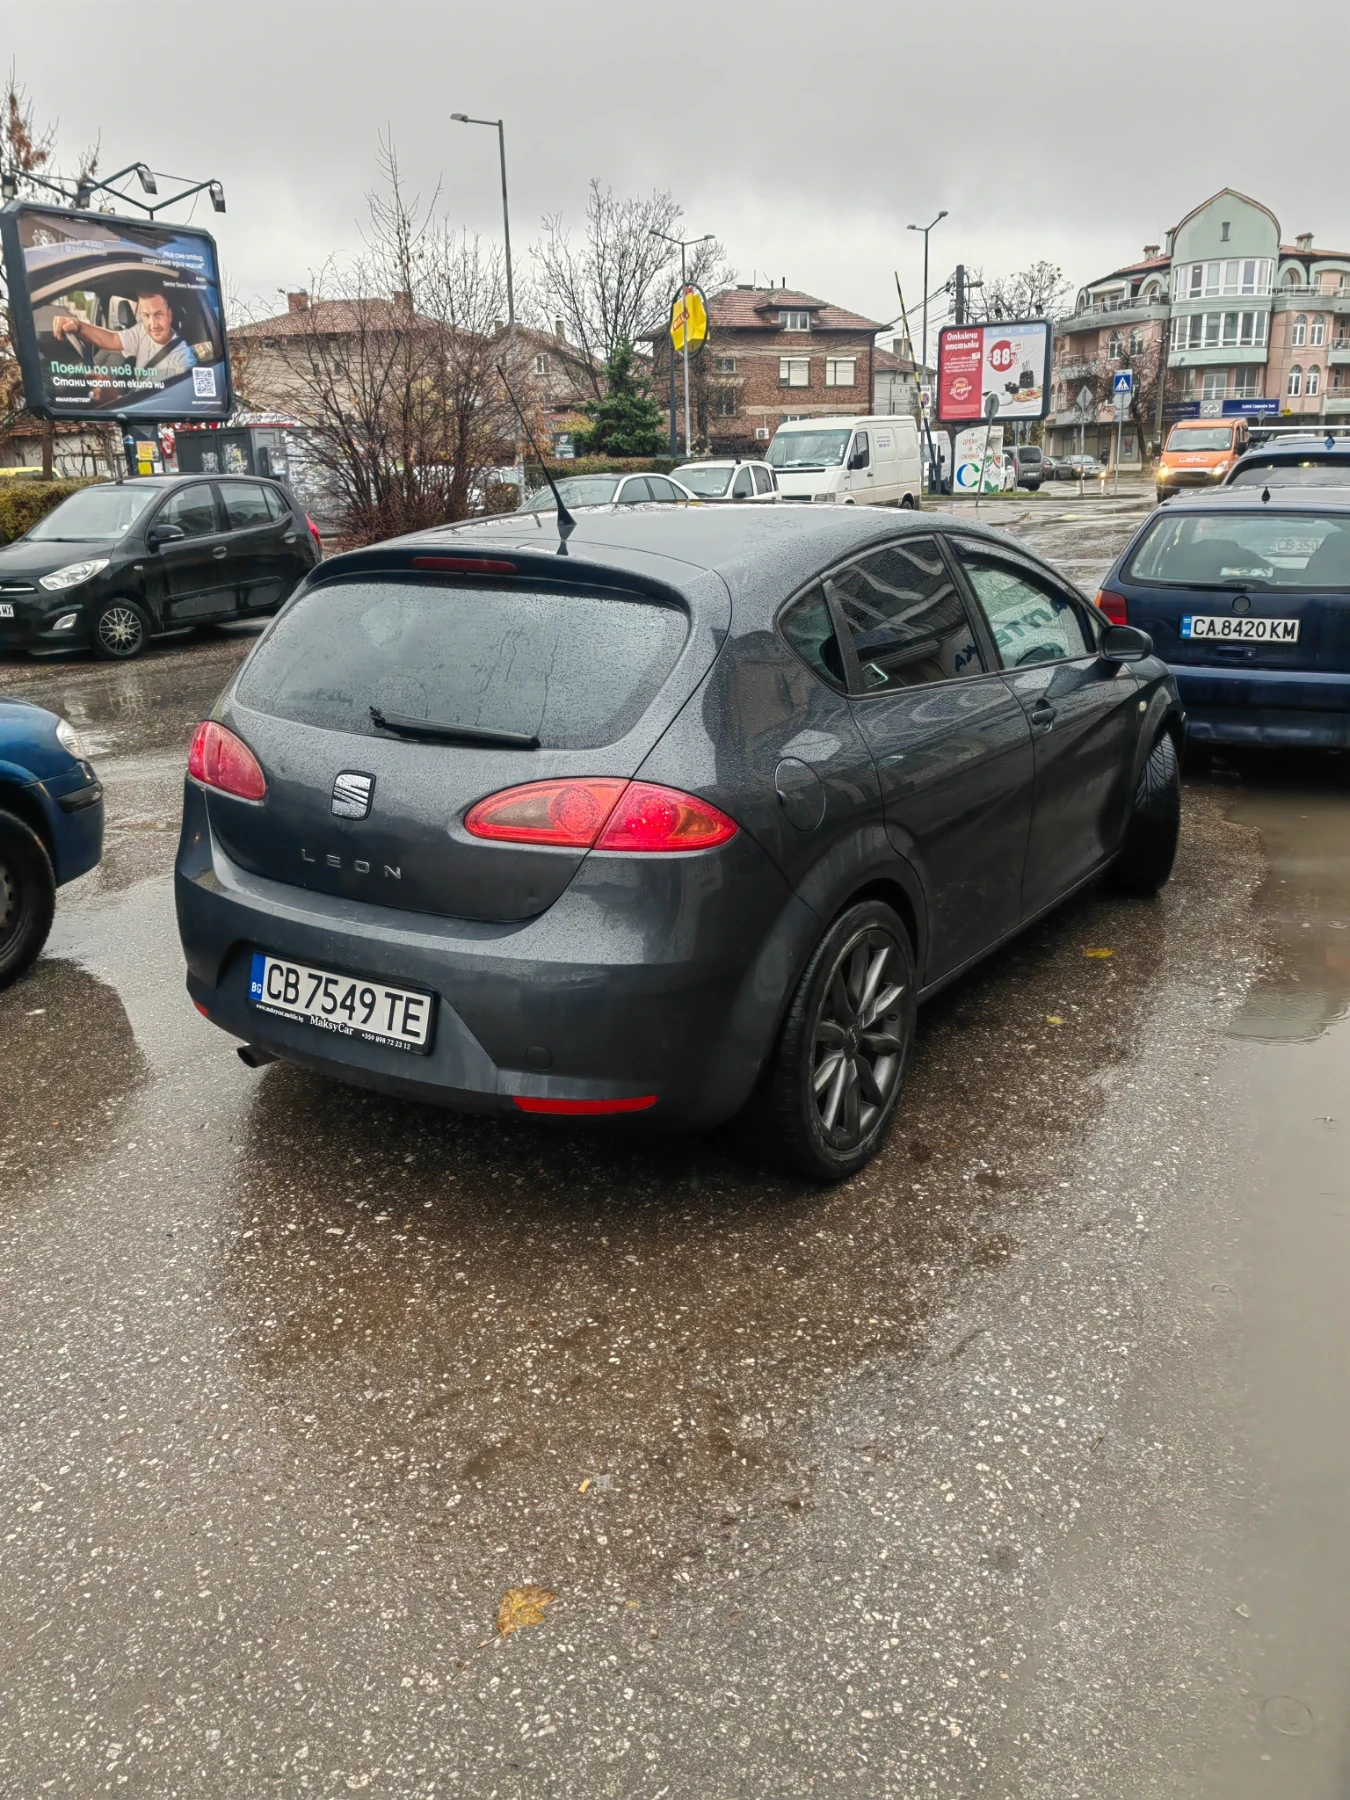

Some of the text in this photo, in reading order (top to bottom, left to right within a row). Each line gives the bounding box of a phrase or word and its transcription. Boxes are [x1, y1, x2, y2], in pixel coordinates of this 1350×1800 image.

[946, 332, 978, 342] Отключи
[945, 340, 980, 351] отстъпки
[51, 360, 158, 376] Поеми по нов път
[52, 376, 86, 388] Стани
[86, 380, 112, 388] част
[126, 379, 153, 389] екипа
[1221, 620, 1266, 638] 8420
[1270, 622, 1296, 640] KM
[301, 848, 402, 880] LEON
[251, 981, 262, 994] BG
[266, 963, 424, 1038] CB 7549 TE
[310, 1016, 354, 1036] MaksyCar
[361, 1032, 374, 1040] +359
